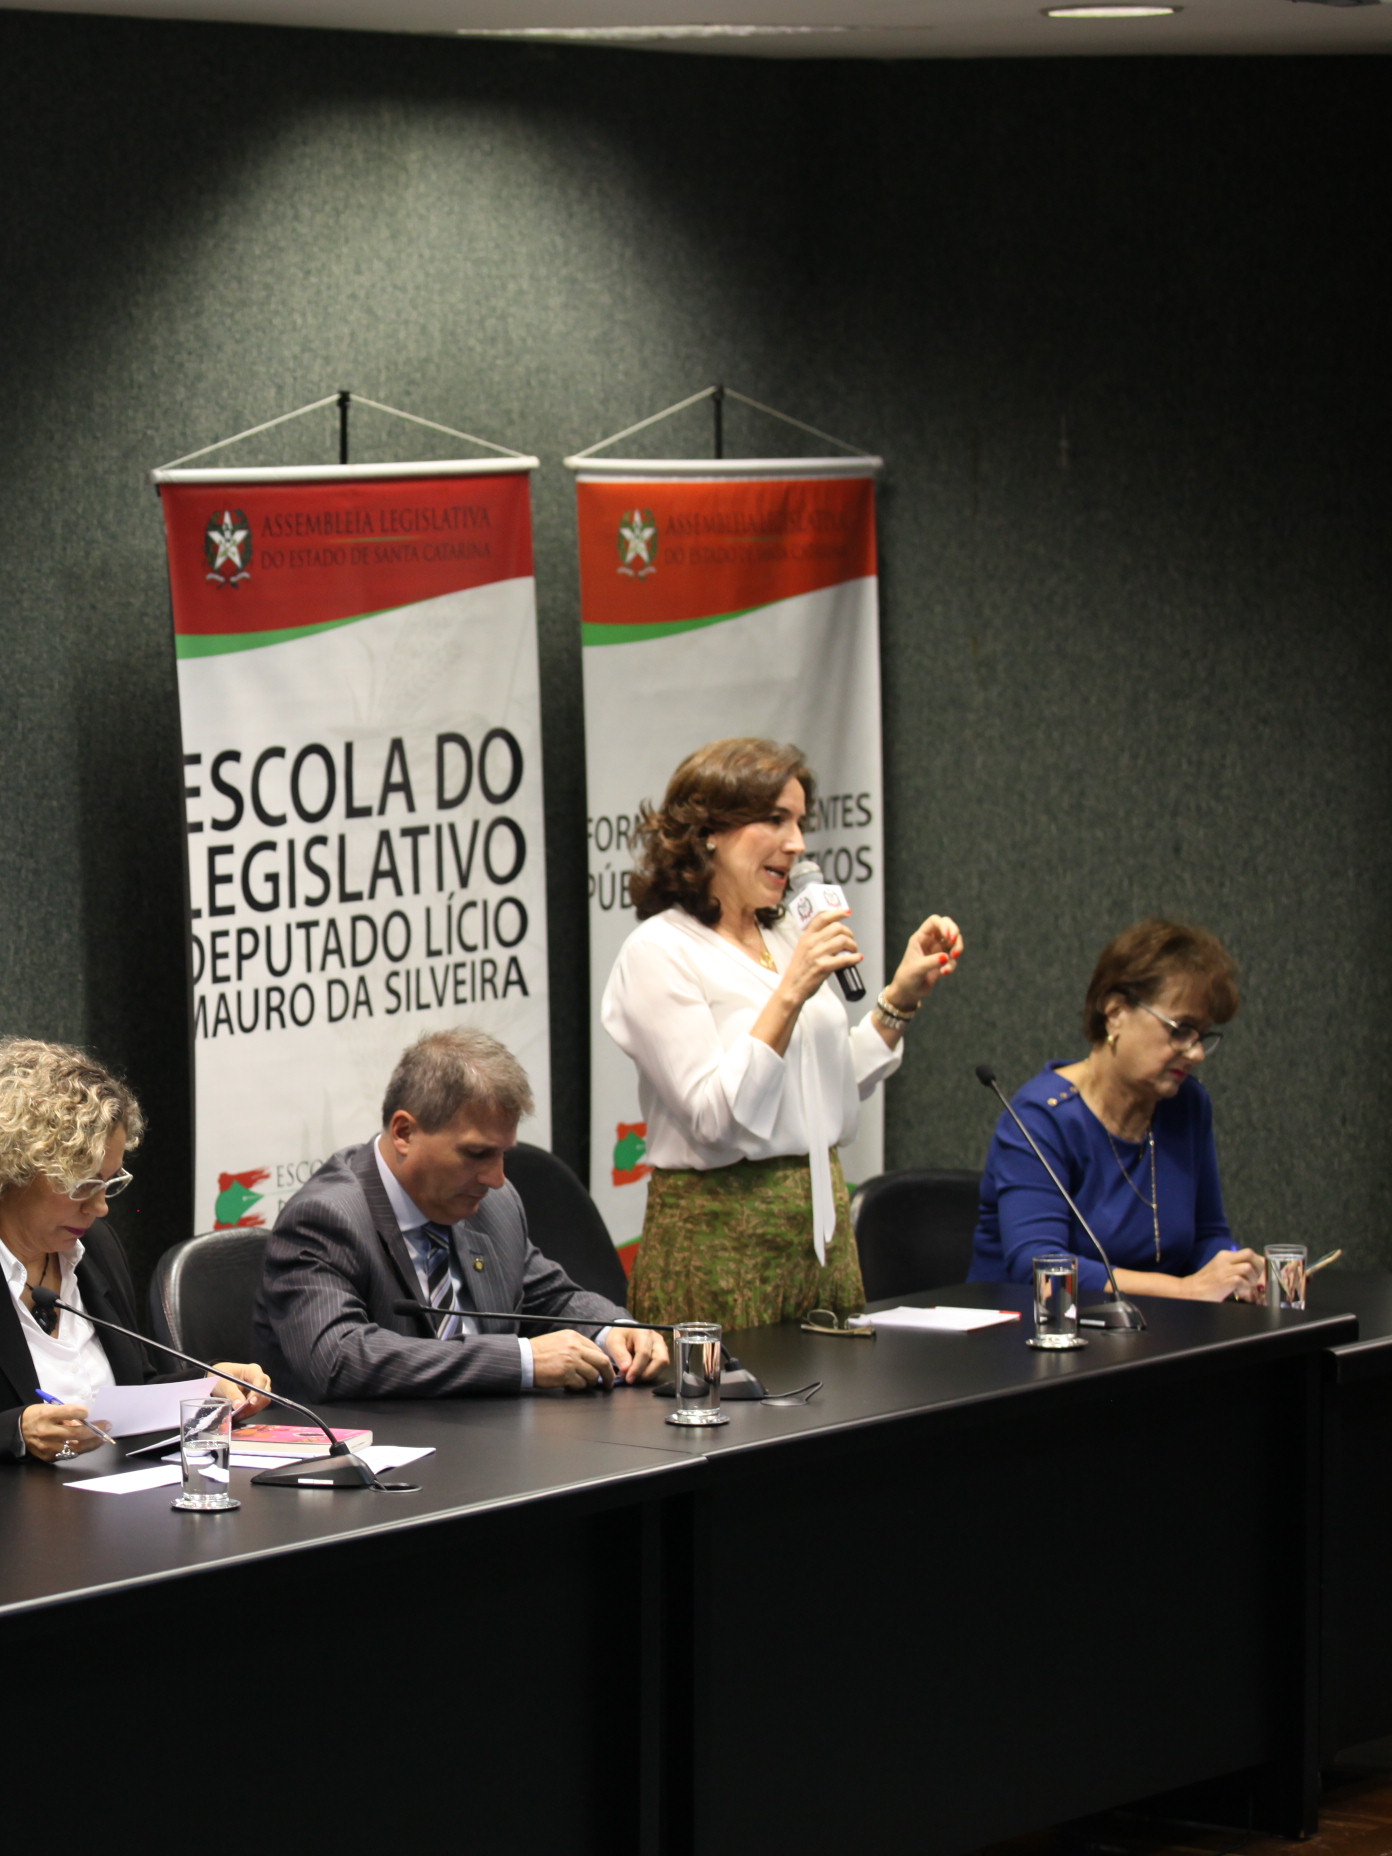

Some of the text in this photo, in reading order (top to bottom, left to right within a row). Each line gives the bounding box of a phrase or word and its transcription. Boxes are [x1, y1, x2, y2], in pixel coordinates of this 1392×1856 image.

[262, 505, 491, 537] ASSEMBLEIA LEGISLATIVA
[261, 541, 491, 569] DO ESTADO DE SANTA CATARINA
[435, 727, 524, 810] DO
[190, 815, 526, 919] EGISLATIVO
[425, 892, 528, 958] LÍCIO
[326, 975, 374, 1023] DA
[385, 955, 529, 1015] SILVEIRA
